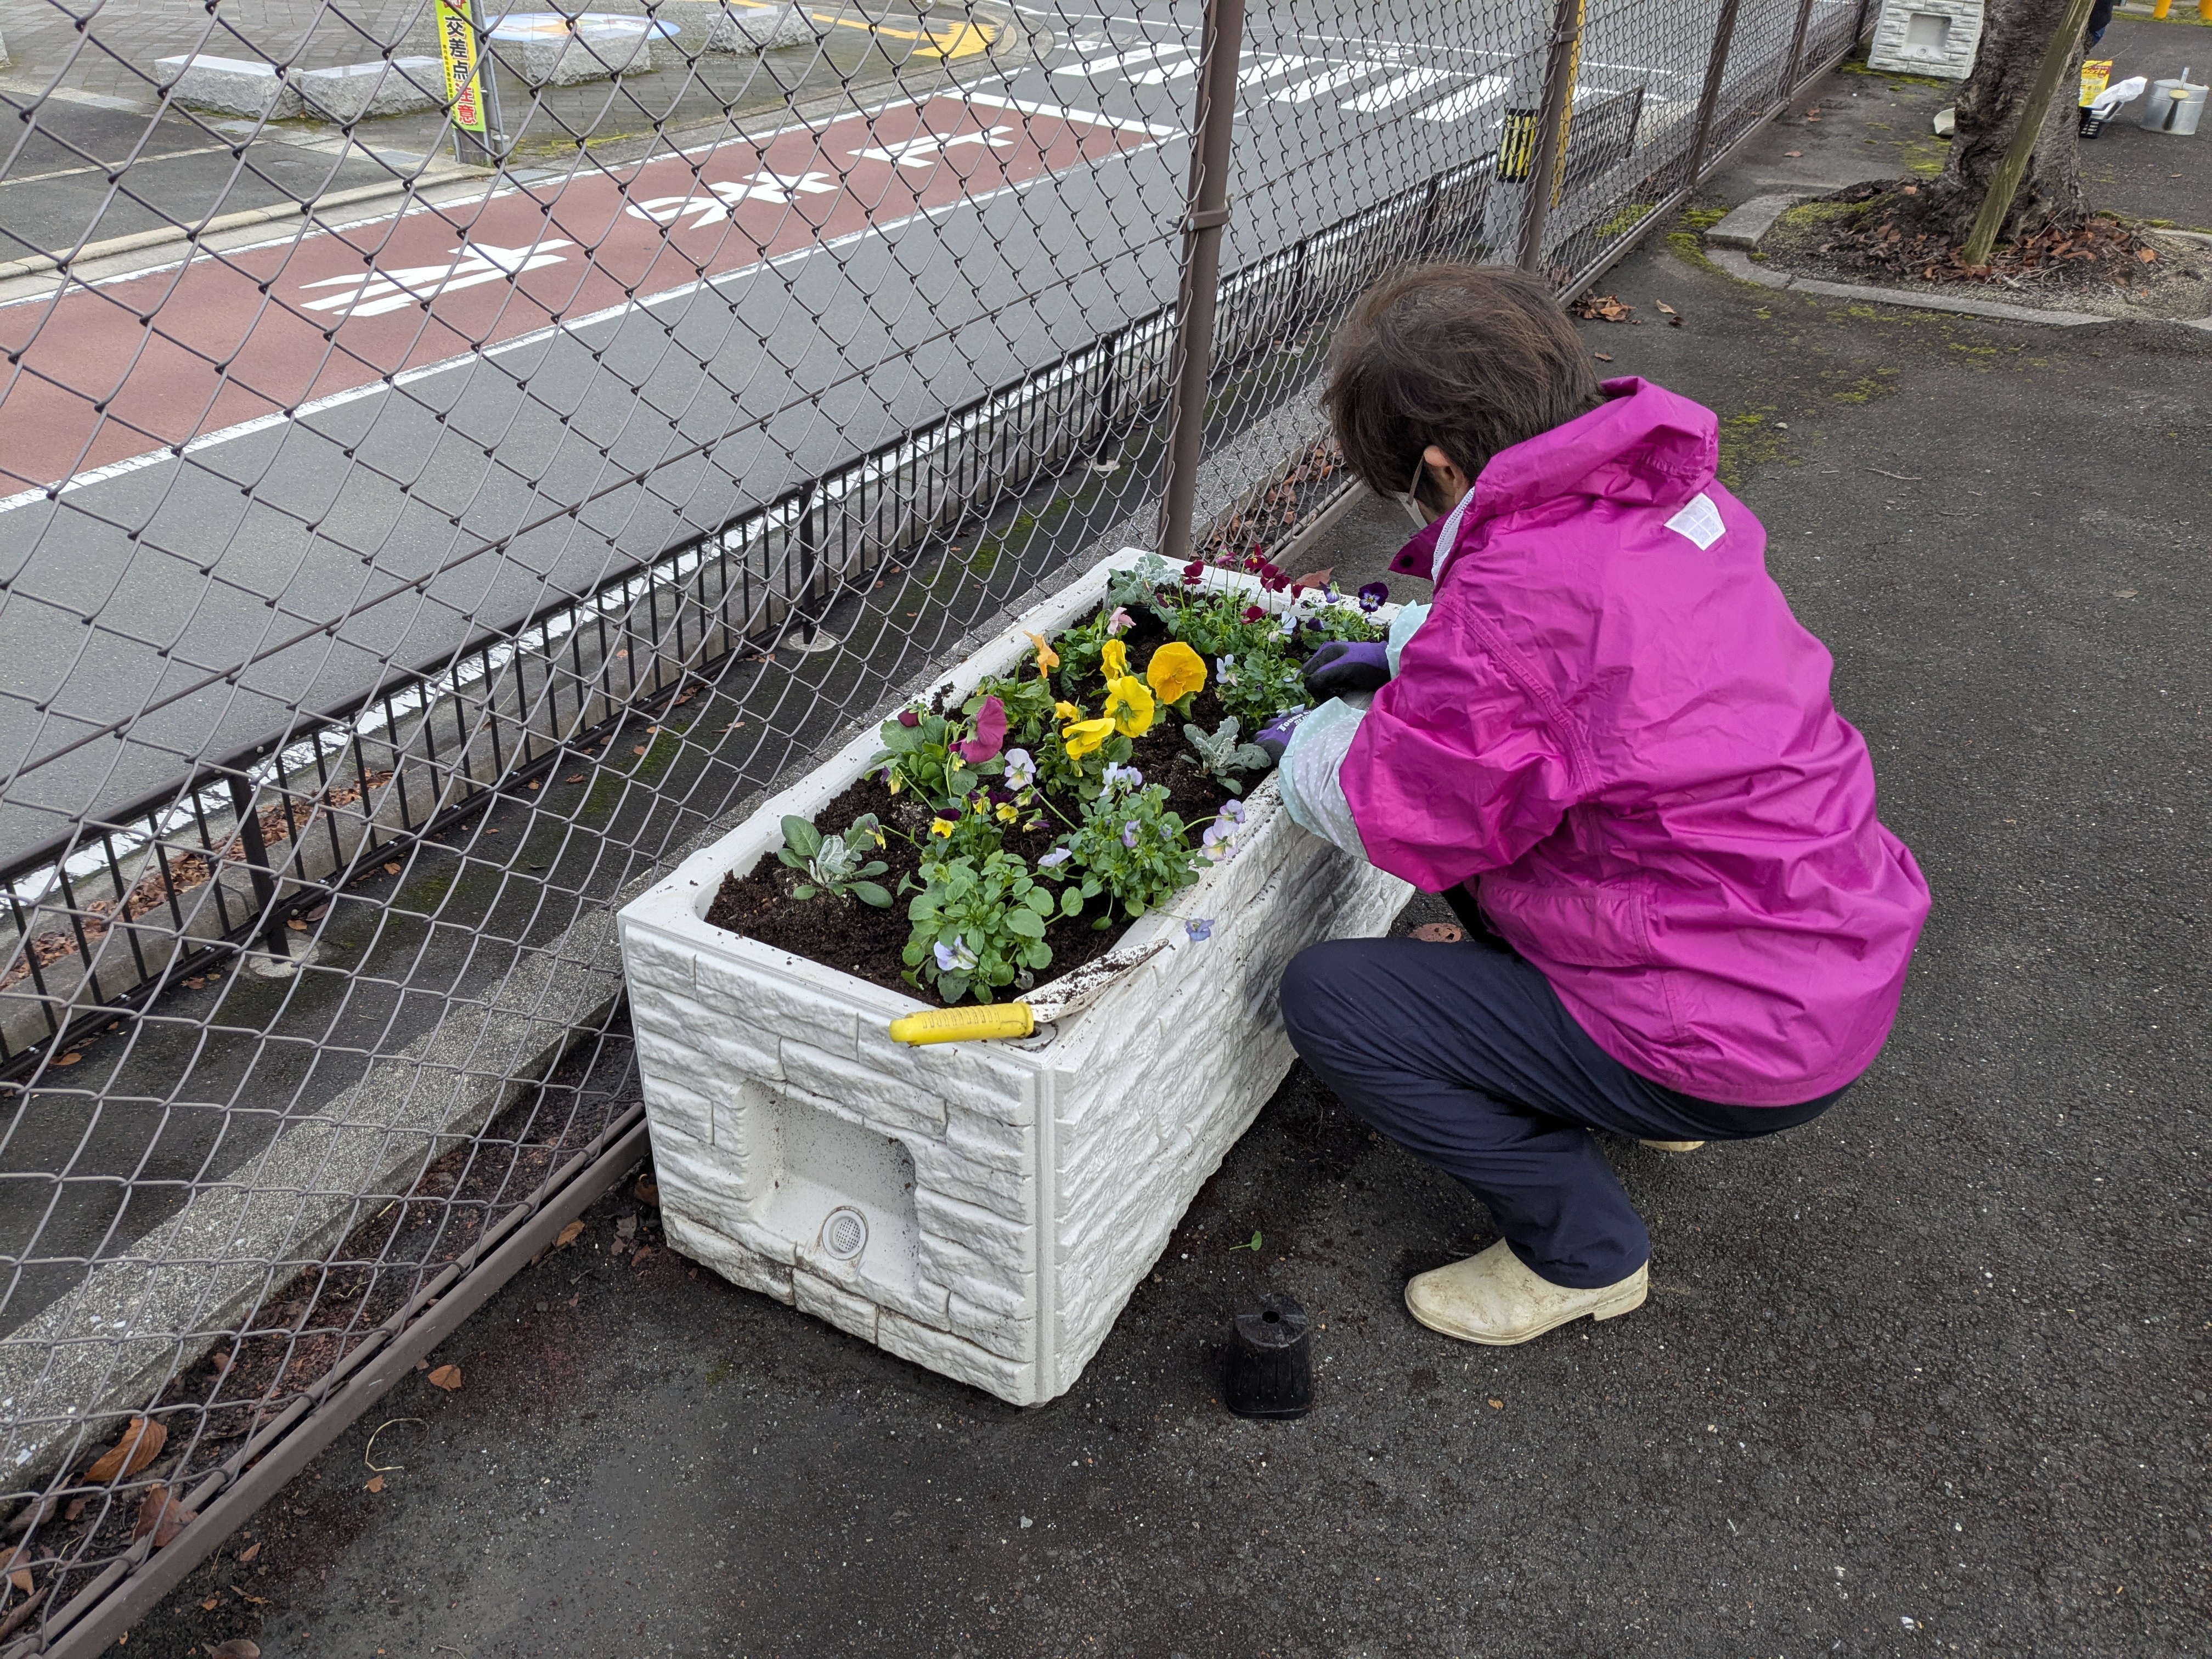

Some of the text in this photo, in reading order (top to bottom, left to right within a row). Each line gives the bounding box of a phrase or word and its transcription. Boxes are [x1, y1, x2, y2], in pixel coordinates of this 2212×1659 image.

[445, 15, 476, 124] 交差点注意
[299, 126, 1014, 317] 止まれ
